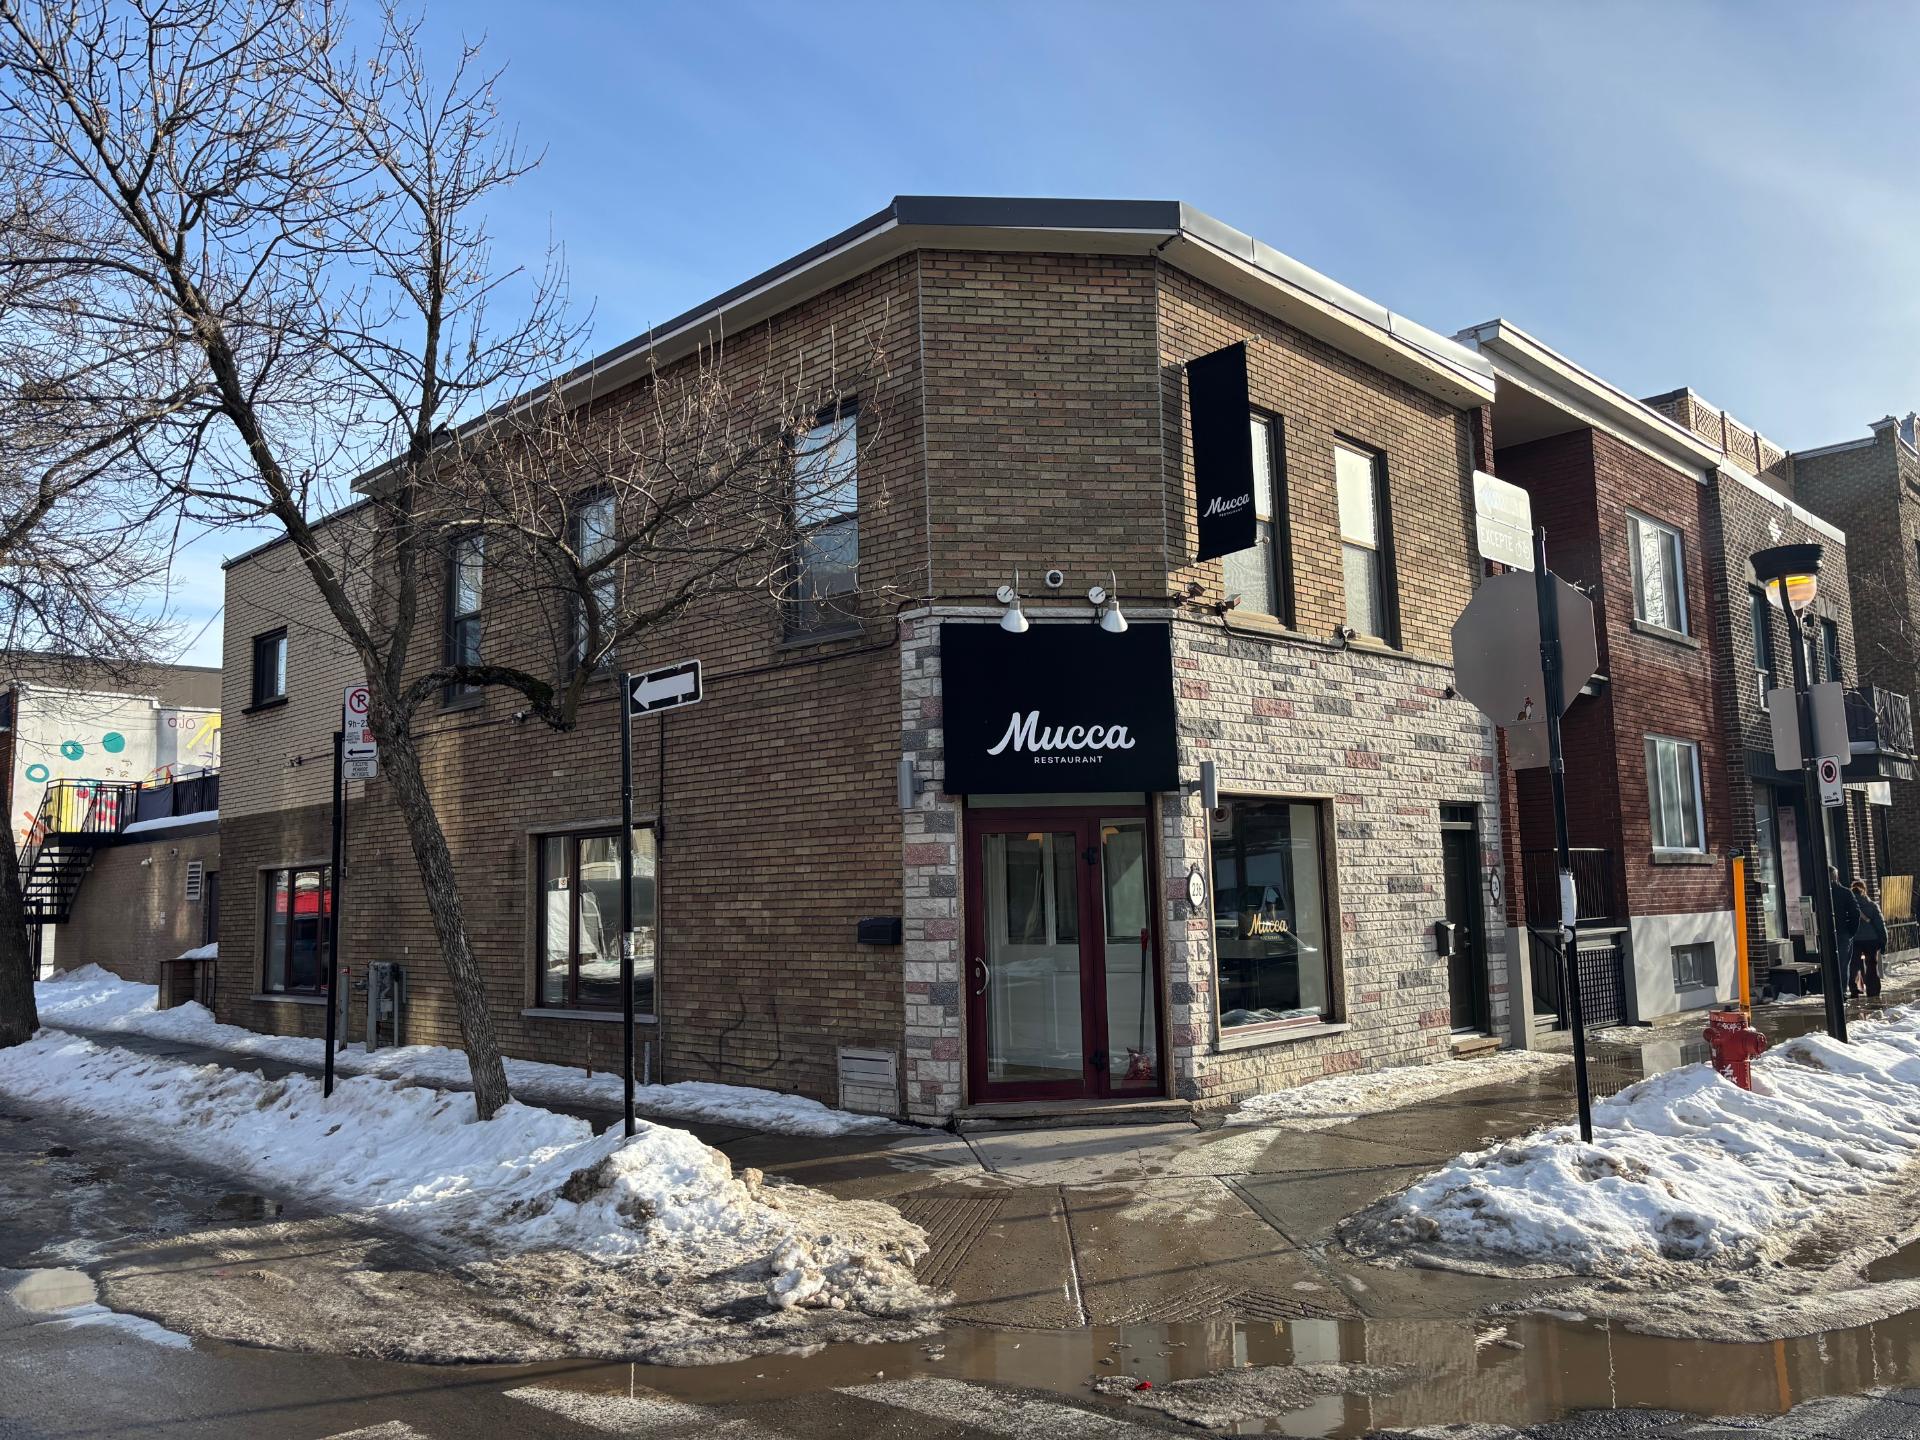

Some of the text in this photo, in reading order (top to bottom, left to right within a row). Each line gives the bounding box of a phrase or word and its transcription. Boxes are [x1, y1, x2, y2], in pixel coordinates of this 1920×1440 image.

[1202, 493, 1250, 517] Mucca
[986, 710, 1136, 756] Mucca
[1034, 755, 1103, 764] RESTAURANT
[1191, 882, 1202, 897] 236
[1247, 912, 1289, 937] Mucca
